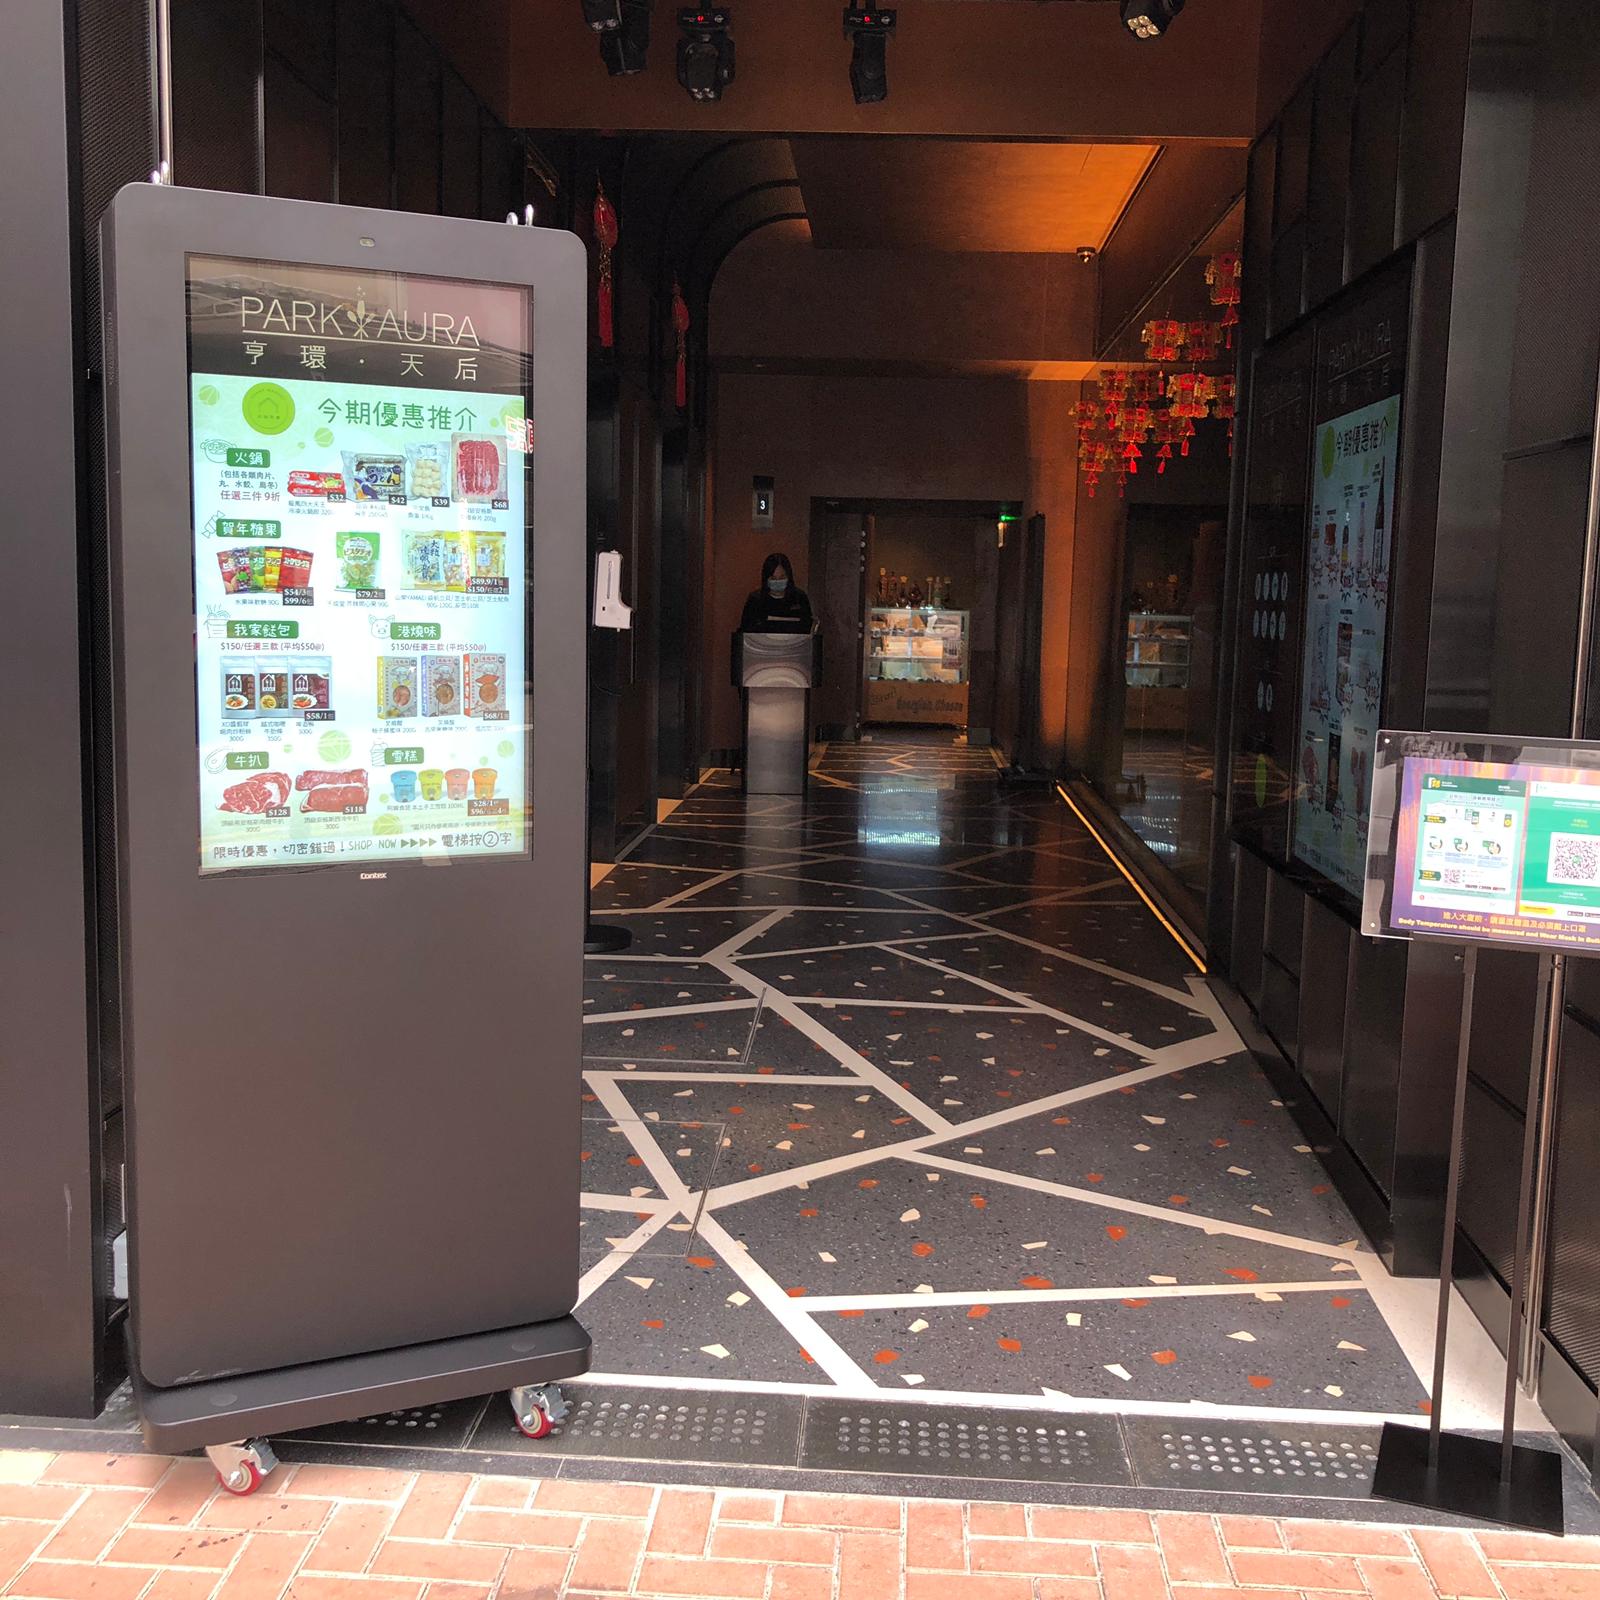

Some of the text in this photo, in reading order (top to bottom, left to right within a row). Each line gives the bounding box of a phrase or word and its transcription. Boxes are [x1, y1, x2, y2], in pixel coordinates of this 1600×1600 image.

[241, 296, 480, 346] PARK AURA
[317, 398, 477, 432] 今期優惠推介
[234, 451, 264, 466] 火鍋
[329, 494, 344, 502] $32
[390, 497, 405, 505] $42
[434, 498, 448, 506] $39
[493, 500, 507, 508] $68
[760, 500, 766, 510] 3
[222, 522, 277, 536] 賀年糖果
[284, 588, 312, 597] $54/3
[357, 590, 384, 598] $79/2
[284, 597, 312, 605] $99/6
[234, 623, 291, 638] 我家餸包
[397, 625, 437, 638] 港燒味
[306, 712, 334, 720] $58/1
[234, 756, 262, 767] 牛扒
[391, 750, 418, 763] 雪糕
[268, 808, 288, 816] $128
[344, 806, 364, 814] $118
[349, 842, 373, 851] SHOP
[379, 839, 397, 849] NOW
[1398, 917, 1415, 926] Body
[1416, 919, 1458, 929] Temperature
[1459, 924, 1481, 932] should
[1491, 928, 1525, 936] measured
